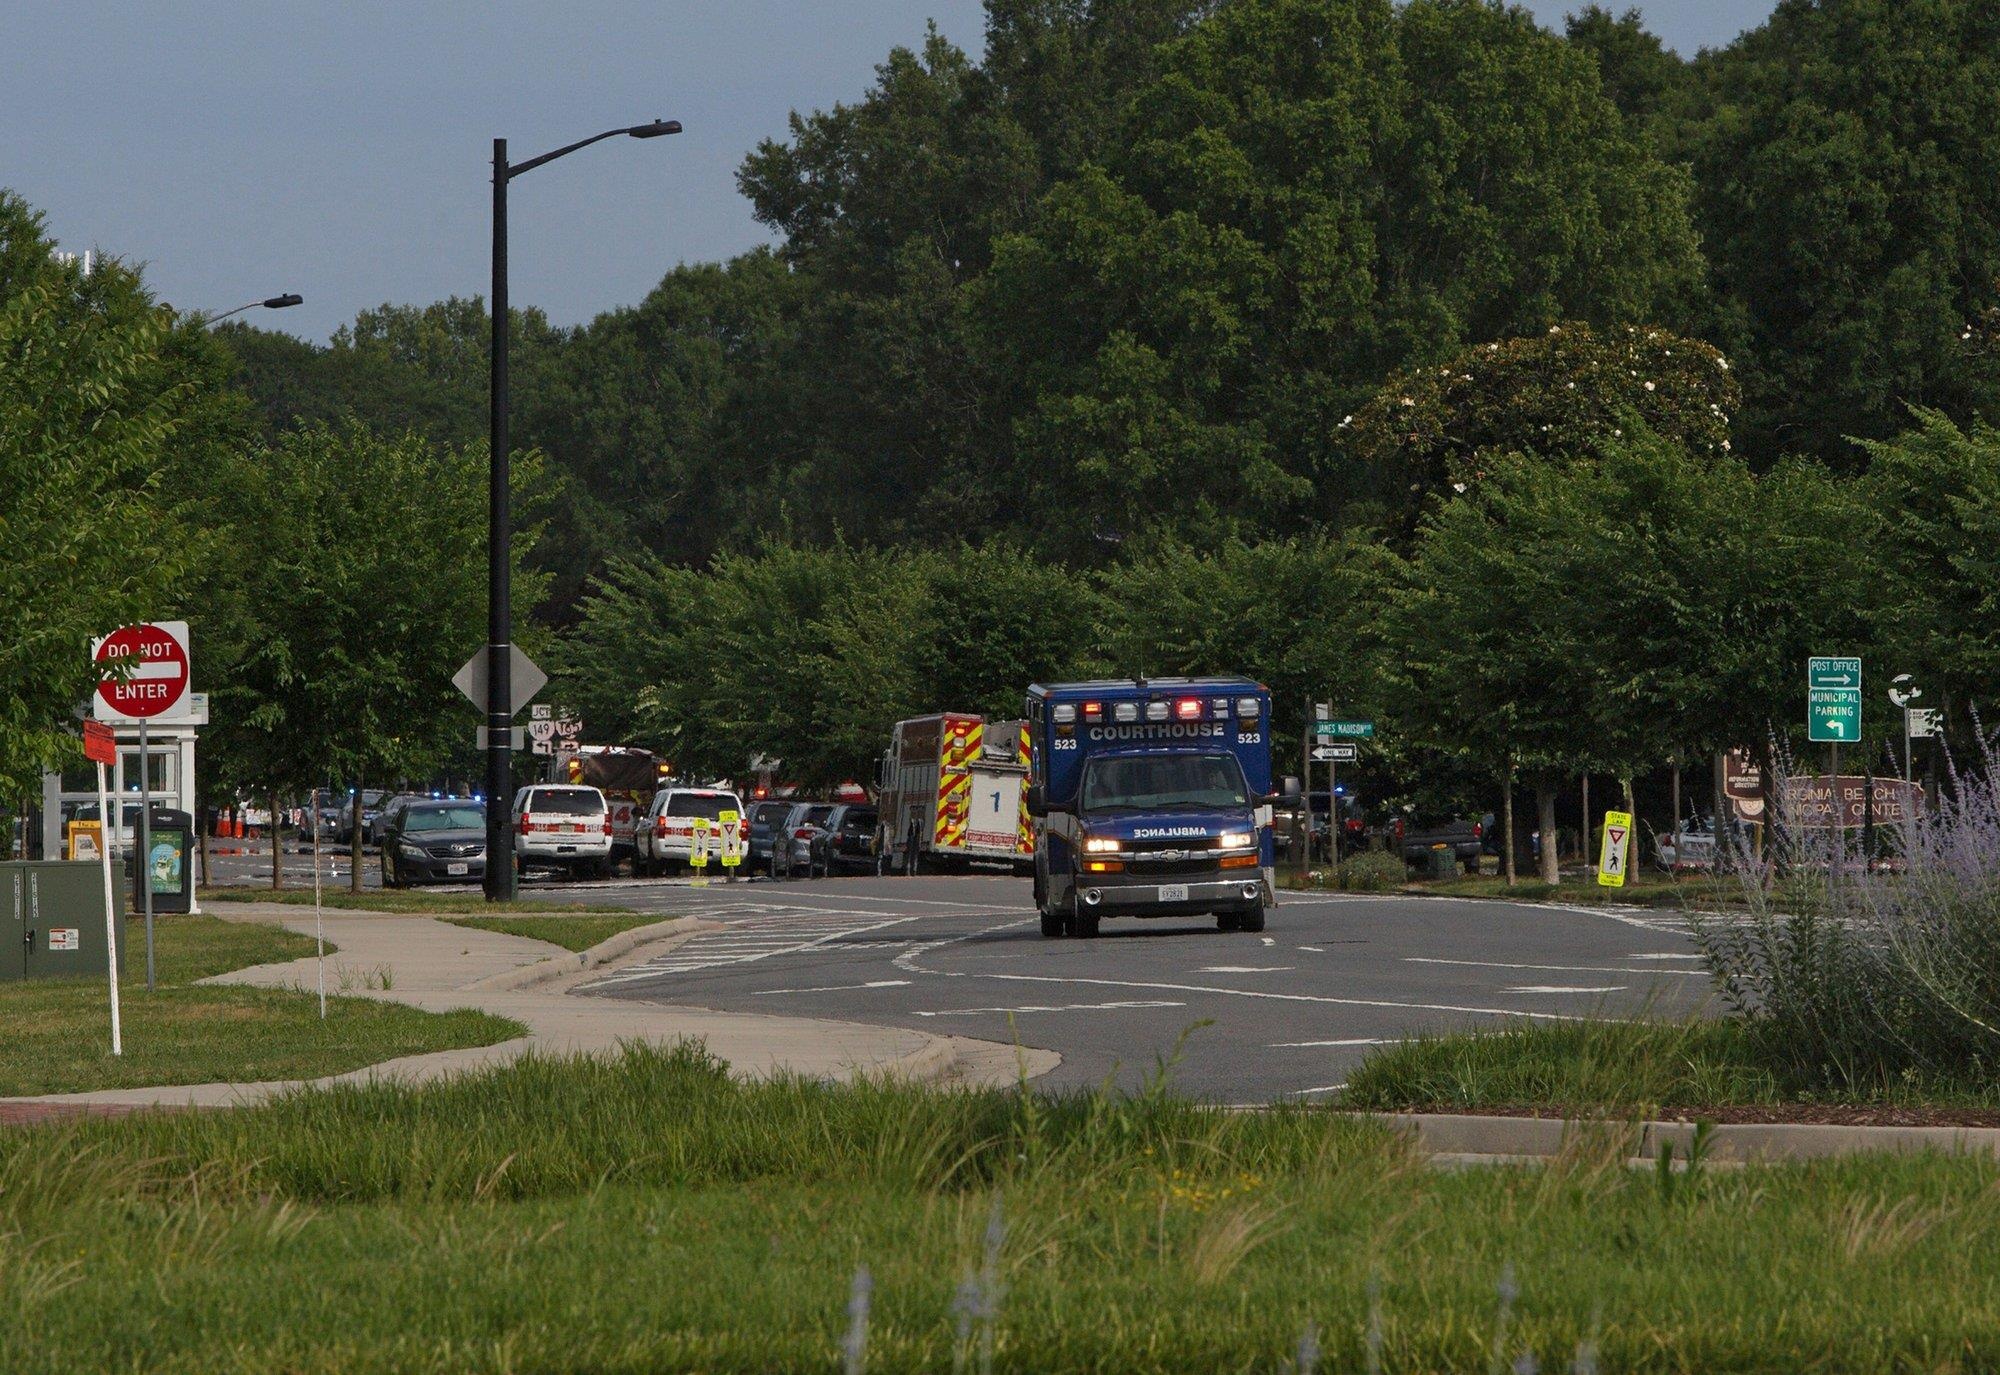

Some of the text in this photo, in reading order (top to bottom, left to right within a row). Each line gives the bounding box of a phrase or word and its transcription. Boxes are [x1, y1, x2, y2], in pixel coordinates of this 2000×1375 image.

[108, 642, 172, 658] DO NOT
[1811, 661, 1858, 672] POST OFFICE
[115, 684, 168, 700] ENTER
[1811, 692, 1858, 703] MUNICIPAL
[533, 706, 550, 717] JCT
[1815, 706, 1854, 717] PARKING
[533, 723, 550, 736] 149
[1090, 722, 1225, 741] COURTHOUSE
[1317, 724, 1336, 733] JAMES
[1337, 724, 1364, 735] MADISON
[1238, 732, 1261, 744] 523
[1054, 739, 1077, 750] 523
[1323, 748, 1351, 756] ONE WAY
[1844, 787, 1896, 801] BECH
[990, 791, 1000, 813] 1
